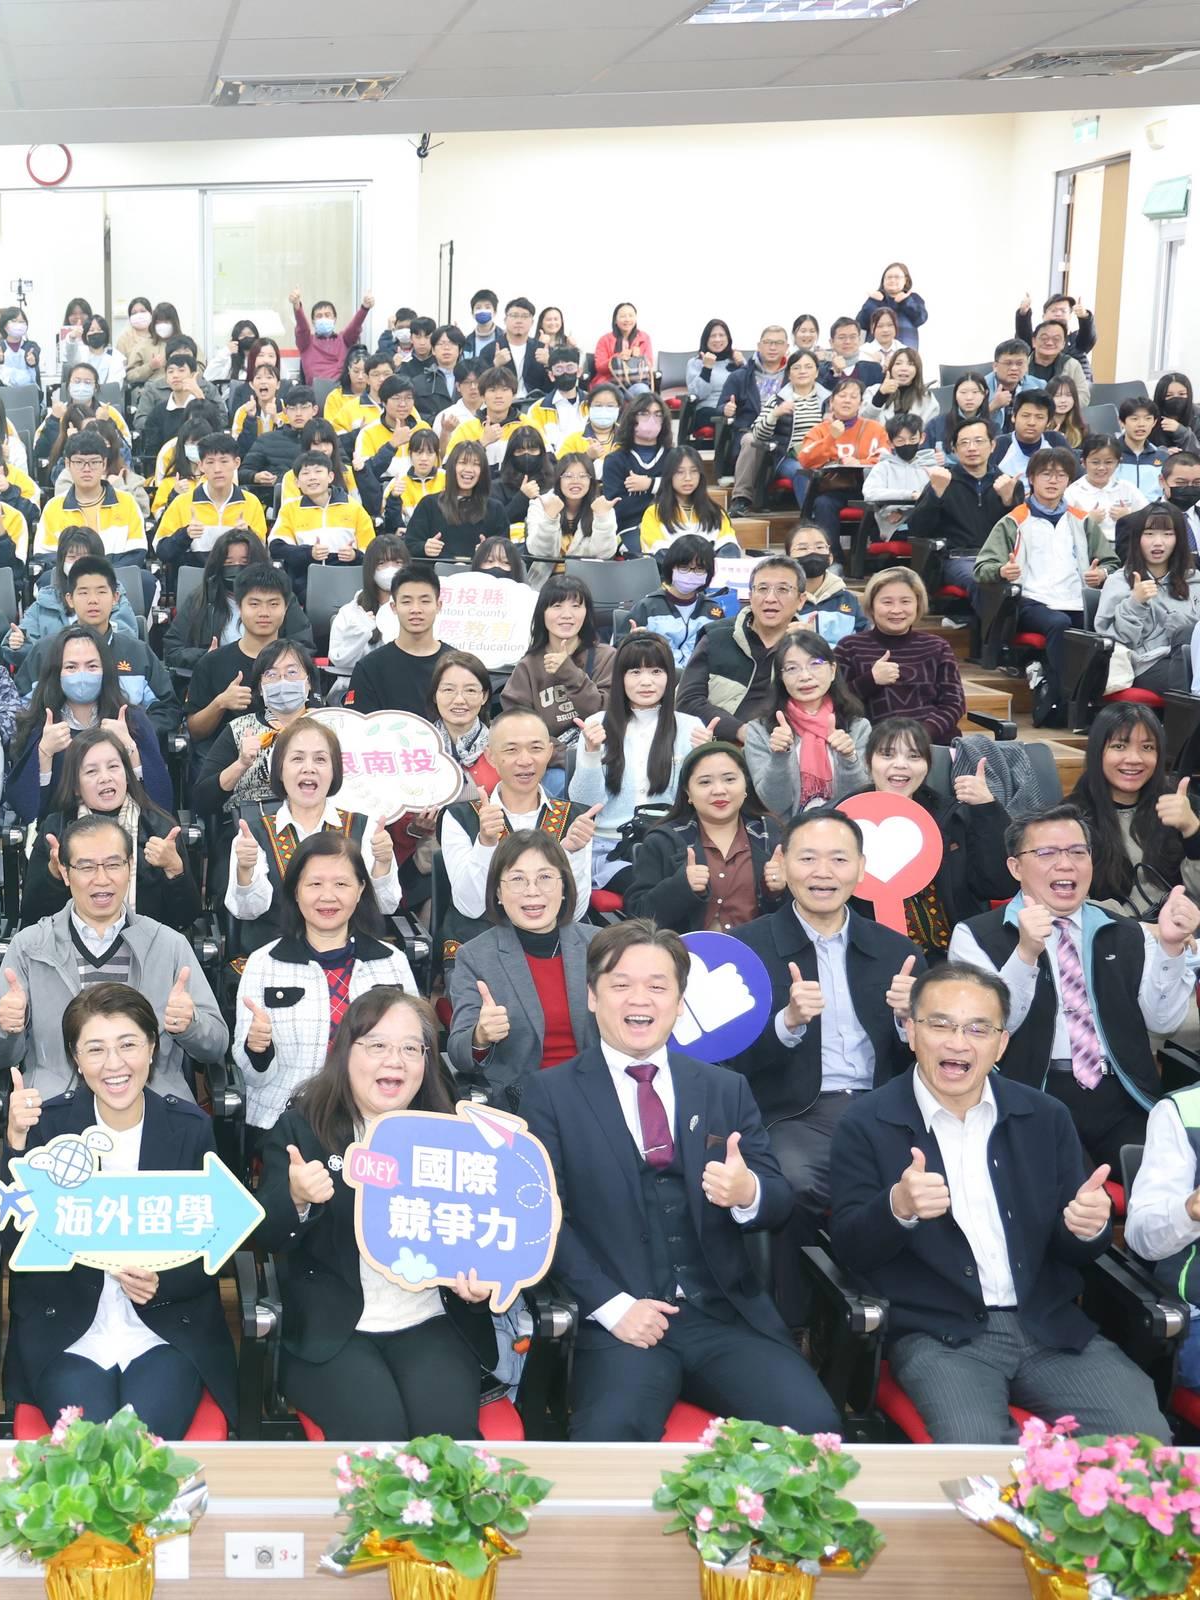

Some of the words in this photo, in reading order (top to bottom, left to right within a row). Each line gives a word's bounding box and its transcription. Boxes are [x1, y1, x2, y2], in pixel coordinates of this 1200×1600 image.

[467, 607, 508, 619] County
[439, 619, 512, 639] 際教育
[468, 641, 525, 652] Education
[539, 684, 569, 708] UC
[411, 1145, 498, 1196] 國際
[54, 1193, 215, 1237] 海外留學
[388, 1195, 517, 1251] 競爭力
[279, 1549, 289, 1561] 3
